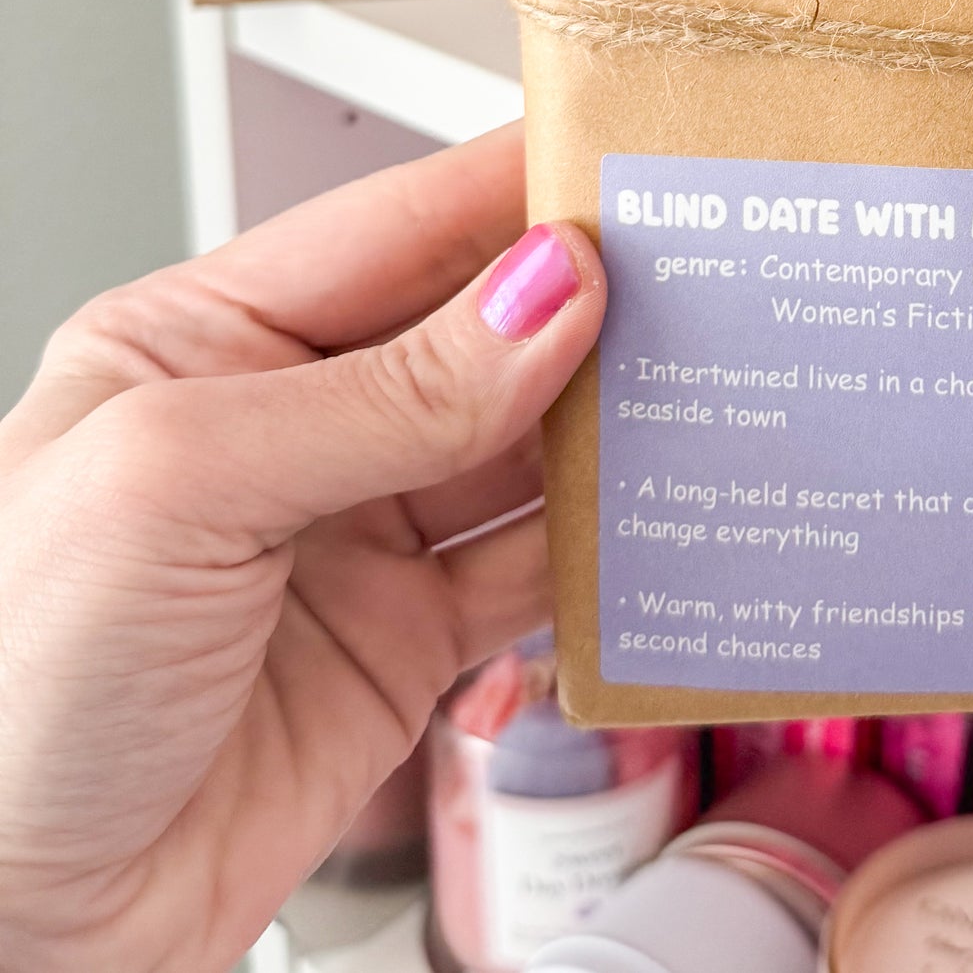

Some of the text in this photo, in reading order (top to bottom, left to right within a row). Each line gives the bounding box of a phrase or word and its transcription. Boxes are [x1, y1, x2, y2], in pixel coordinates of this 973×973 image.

[617, 189, 727, 229] BLIND
[743, 196, 839, 235] DATE
[855, 201, 955, 240] WITH
[655, 255, 747, 281] genre:
[760, 255, 963, 294] Contemporary
[770, 298, 896, 328] Women's
[637, 358, 798, 389] Intertwined
[808, 365, 867, 392] lives
[879, 368, 900, 394] in
[910, 377, 924, 395] a
[618, 398, 786, 427] seaside town
[637, 476, 655, 499] A
[666, 480, 786, 509] long-held
[796, 487, 885, 510] secret
[894, 488, 952, 513] that
[618, 515, 860, 554] change everything
[638, 591, 724, 621] Warm,
[733, 598, 801, 628] witty
[812, 601, 965, 632] friendships
[619, 631, 822, 659] second chances
